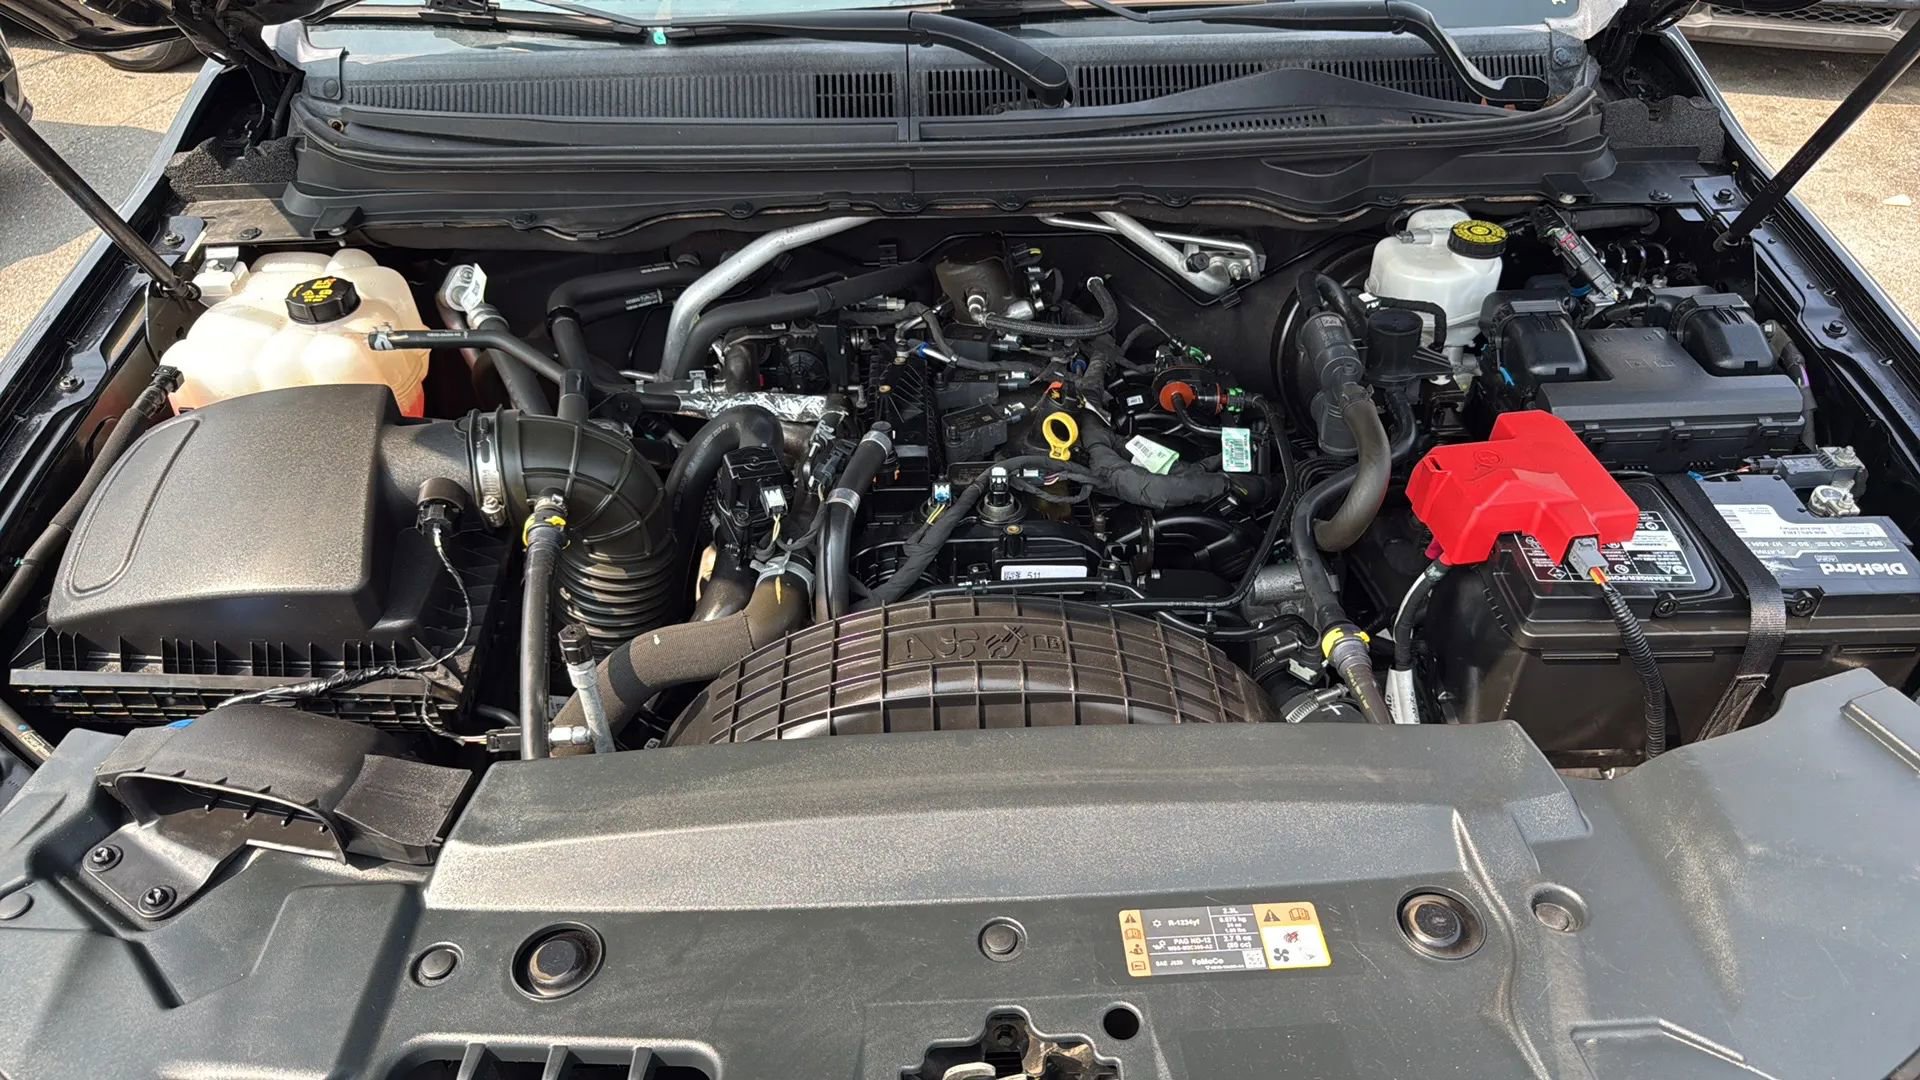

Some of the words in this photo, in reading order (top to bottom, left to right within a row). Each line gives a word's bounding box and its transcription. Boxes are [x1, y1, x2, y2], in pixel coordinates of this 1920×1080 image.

[1820, 562, 1908, 576] DieHard
[1167, 918, 1200, 927] R-1234yf
[1192, 957, 1224, 966] FoMoCo
